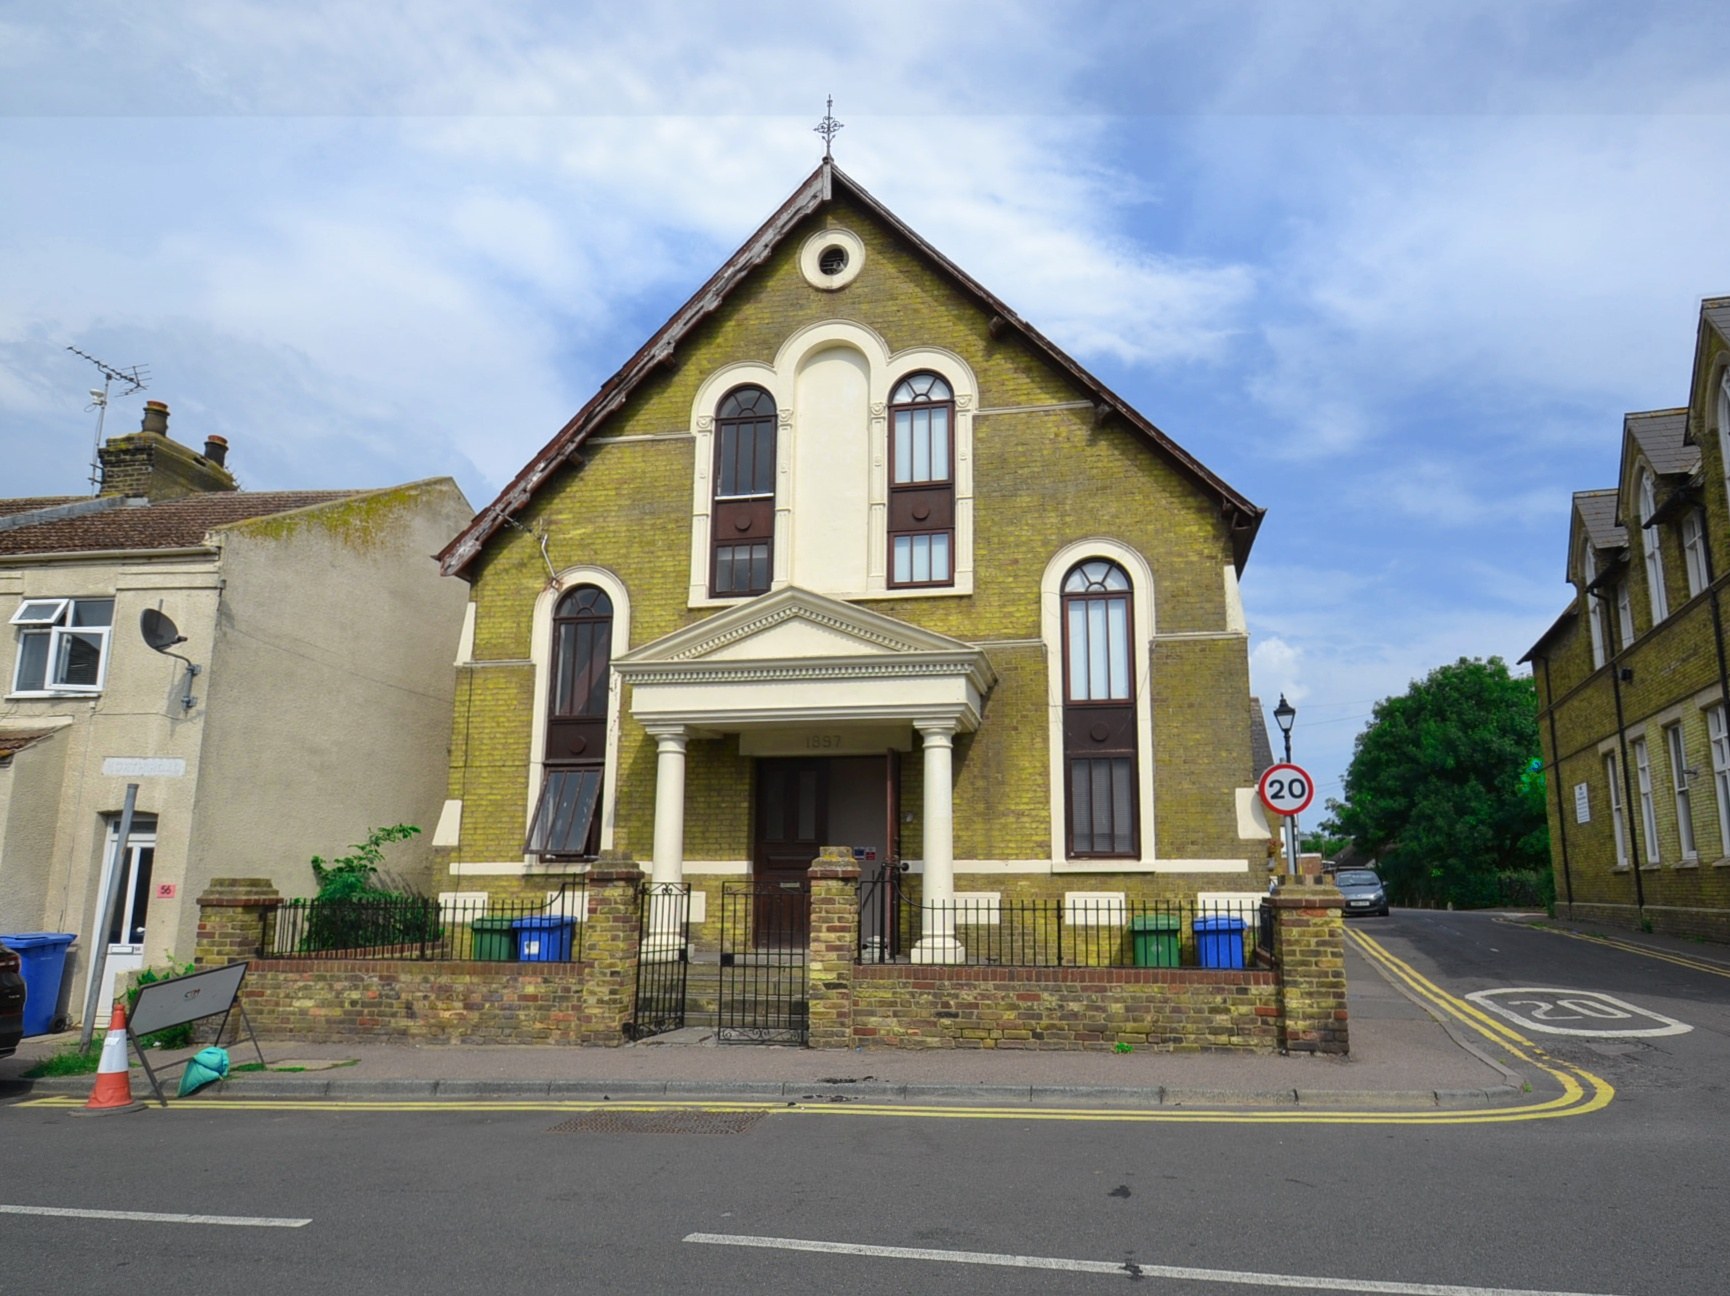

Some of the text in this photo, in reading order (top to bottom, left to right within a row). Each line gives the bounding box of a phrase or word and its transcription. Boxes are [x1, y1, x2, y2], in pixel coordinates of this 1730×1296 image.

[806, 735, 841, 749] 1897
[1269, 778, 1306, 800] 20
[160, 884, 172, 895] 56
[1508, 1000, 1632, 1020] 20
